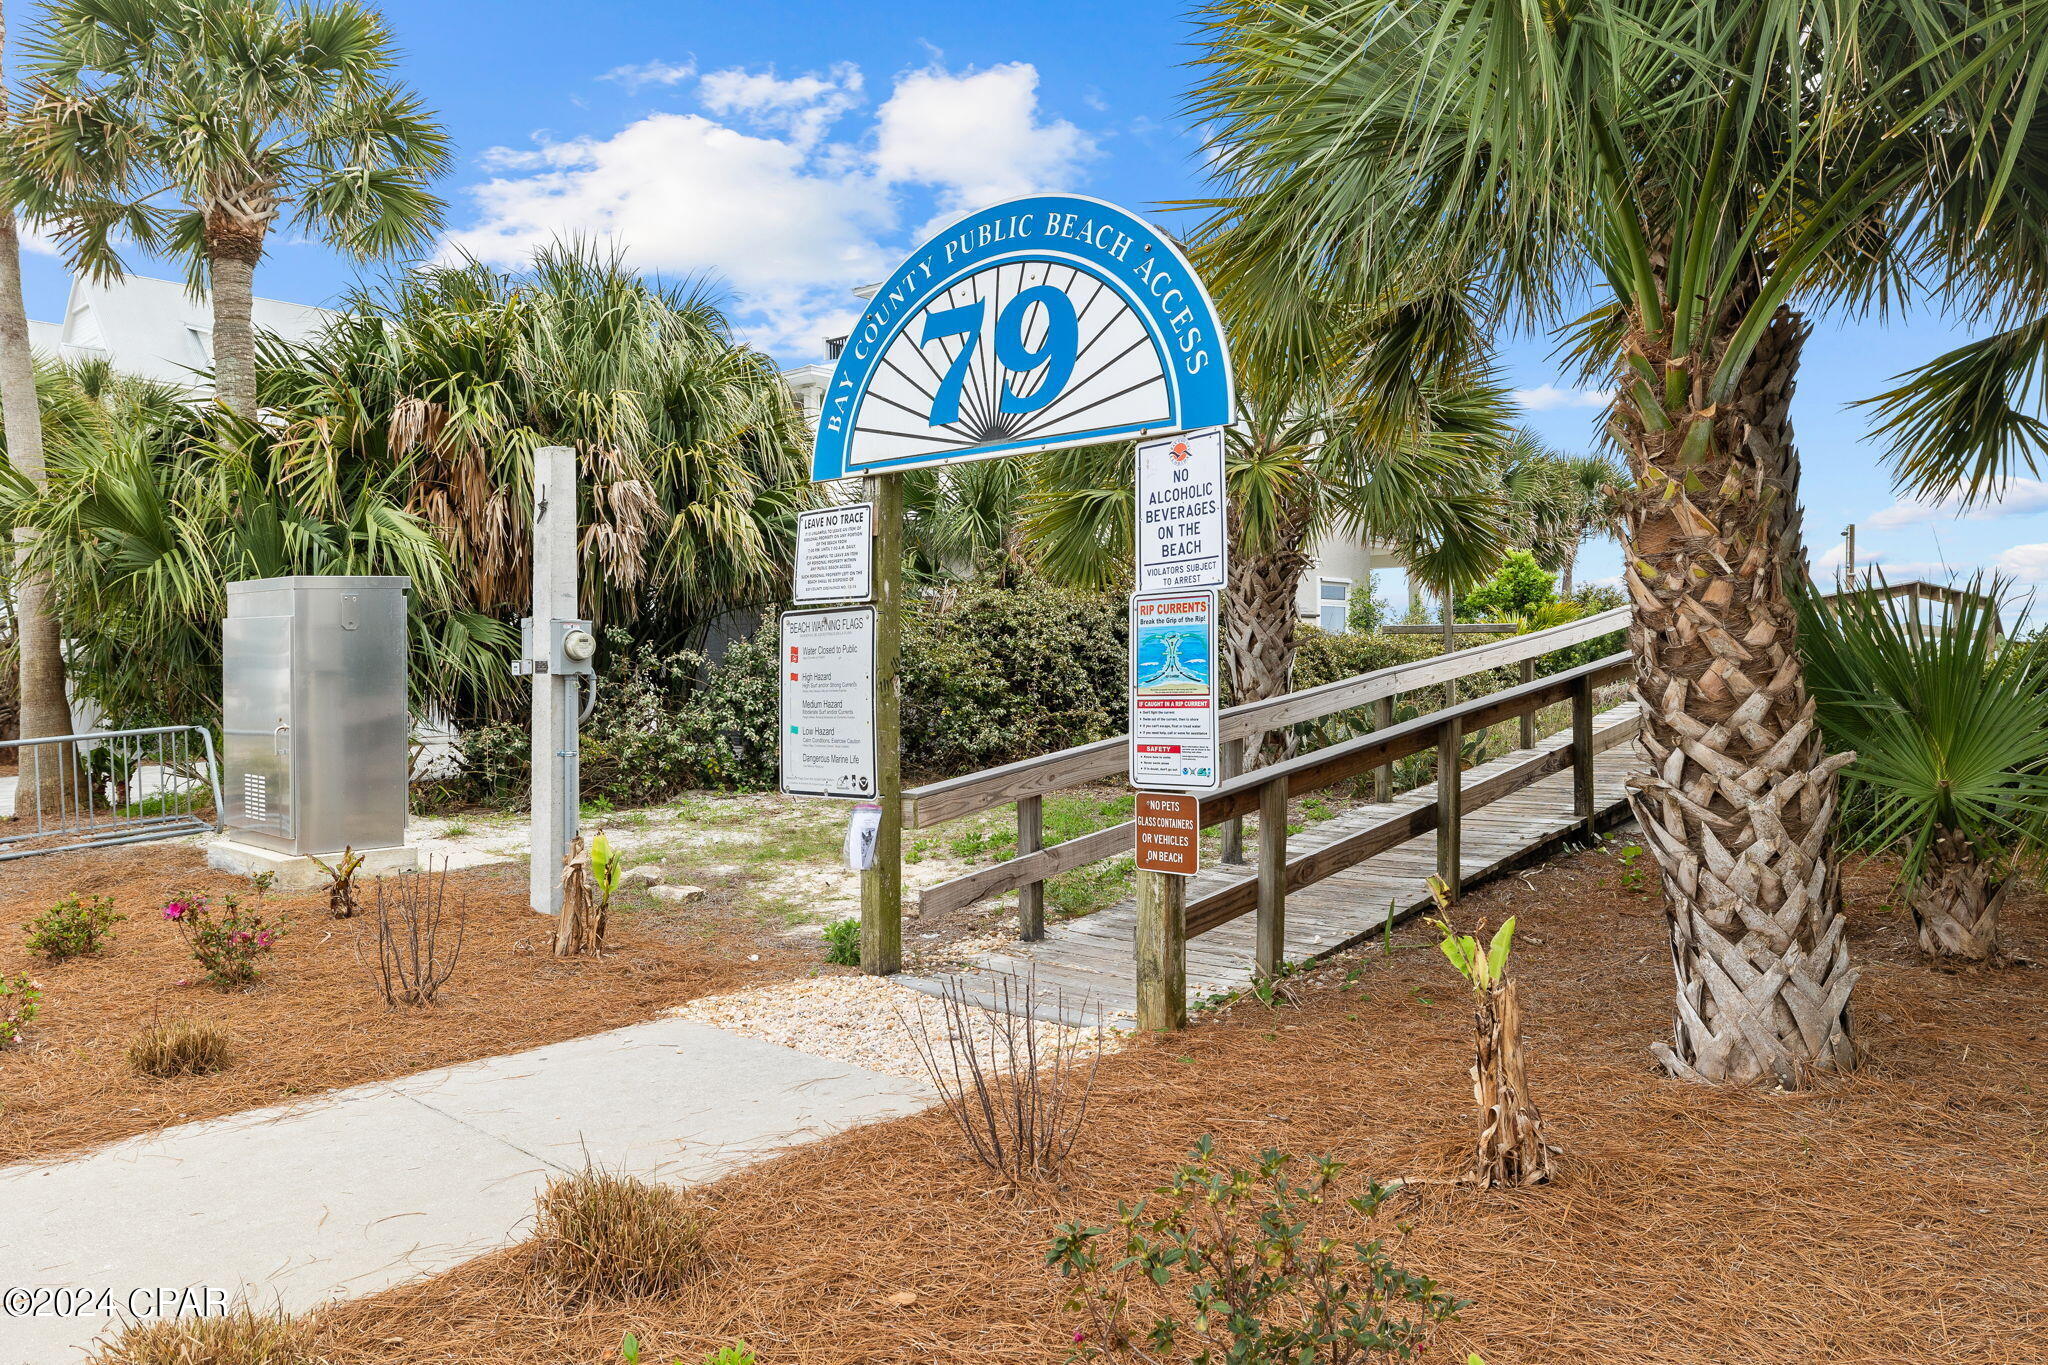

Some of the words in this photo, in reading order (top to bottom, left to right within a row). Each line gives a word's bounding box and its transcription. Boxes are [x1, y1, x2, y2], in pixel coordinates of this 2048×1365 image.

[828, 370, 854, 434] BAY
[855, 256, 933, 360] COUNTY
[944, 213, 1034, 263] PUBLIC
[1045, 212, 1134, 261] BEACH
[1133, 258, 1209, 375] ACCESS
[920, 285, 1079, 428] 79
[1173, 468, 1188, 483] NO
[1149, 482, 1212, 505] ALCOHOLIC
[1146, 500, 1216, 523] BEVERAGES
[804, 517, 824, 529] LEAVE
[826, 516, 838, 526] NO
[840, 512, 863, 524] TRACE
[1158, 526, 1173, 539] ON
[1179, 522, 1200, 537] THE
[1162, 540, 1201, 557] BEACH
[1147, 565, 1183, 576] VIOLATORS
[1186, 561, 1216, 573] SUBJECT
[1163, 578, 1172, 586] TO
[1174, 575, 1200, 586] ARREST
[1140, 605, 1154, 615] RIP
[1157, 601, 1206, 614] CURRENTS
[790, 622, 810, 634] BEACH
[812, 619, 840, 632] WARNING
[843, 618, 863, 629] FLAGS
[1166, 617, 1177, 625] Grip
[803, 647, 817, 655] Water
[818, 646, 835, 655] Closed
[843, 644, 857, 653] Public
[802, 673, 812, 683] High
[802, 700, 822, 708] Medium
[824, 700, 842, 708] Hazard
[815, 727, 834, 735] Hazard
[803, 754, 829, 764] Dangerous
[831, 755, 848, 763] Marine
[850, 755, 859, 763] Life
[1150, 801, 1160, 810] NO
[1162, 801, 1180, 812] PETS
[1138, 816, 1156, 826] GLASS
[1158, 818, 1194, 830] CONTAINERS
[1142, 833, 1152, 843] OR
[1154, 835, 1189, 846] VEHICLES
[1148, 851, 1158, 860] ON
[1159, 852, 1183, 863] BEACH
